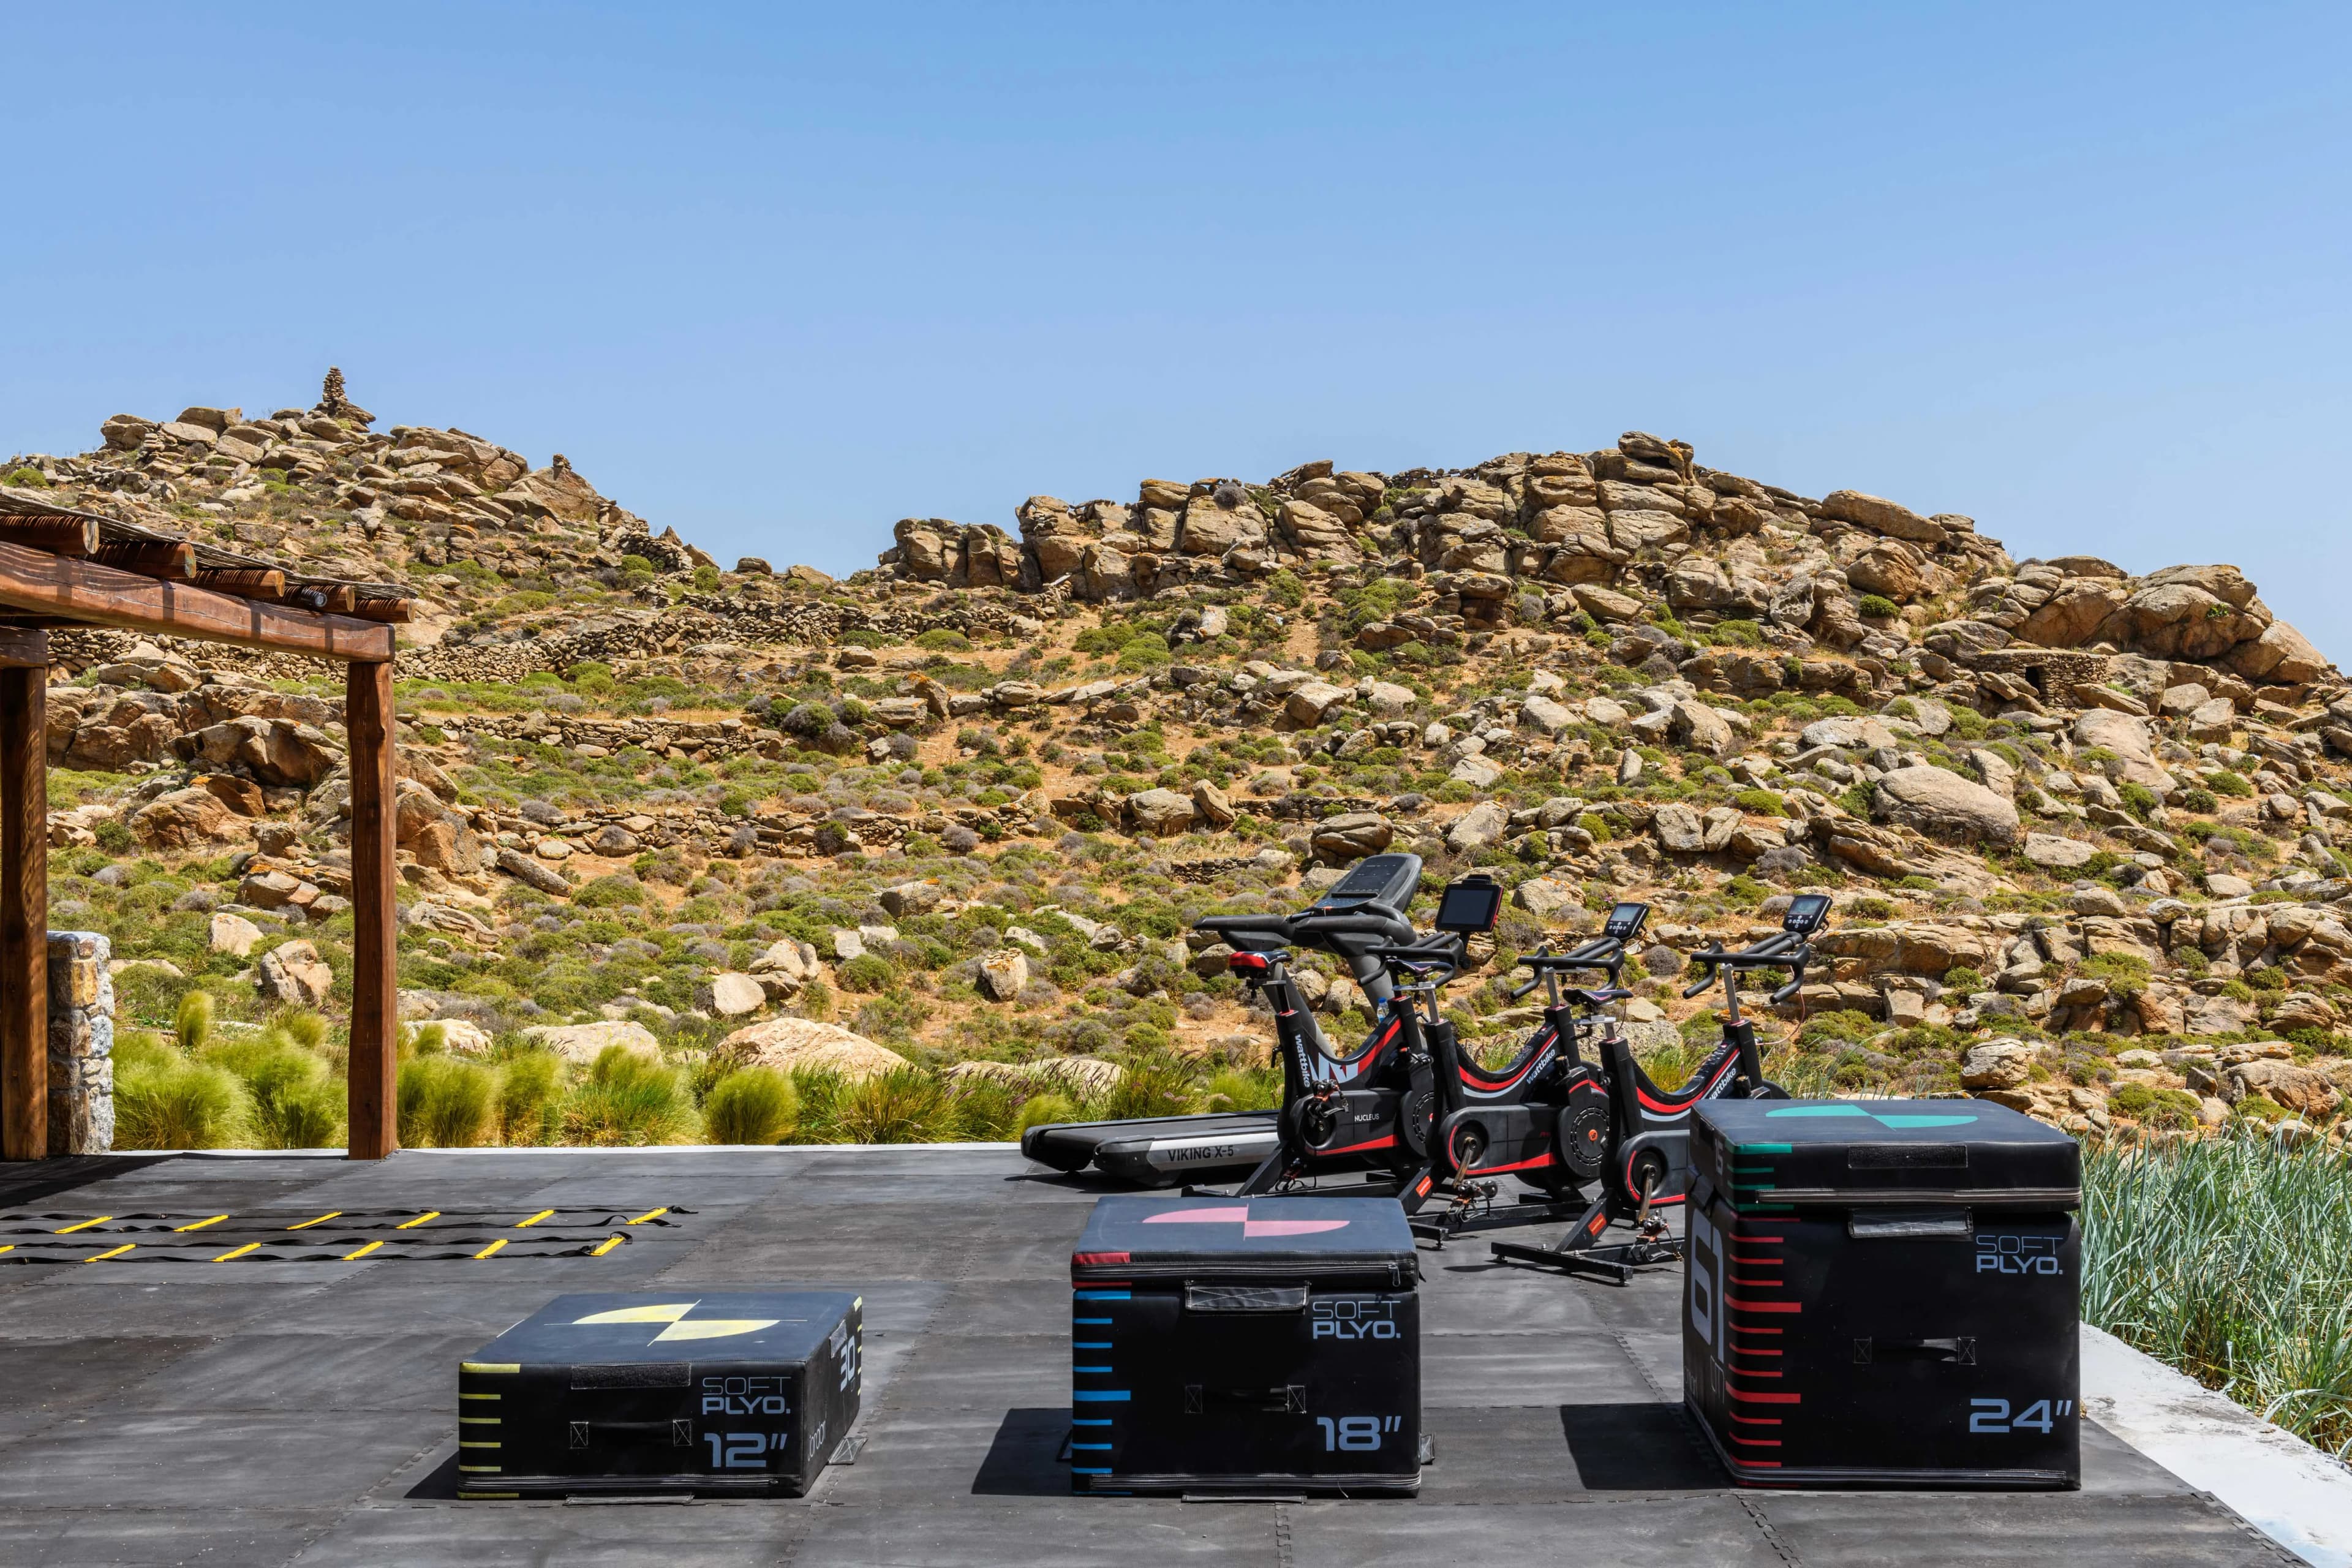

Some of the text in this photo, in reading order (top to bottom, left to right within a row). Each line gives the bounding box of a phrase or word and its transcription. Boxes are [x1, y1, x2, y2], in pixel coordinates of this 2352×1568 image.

[1294, 1033, 1311, 1088] wattbike
[1526, 1048, 1556, 1085] wattbike
[1354, 1113, 1380, 1122] NUCLEUS
[1167, 1145, 1234, 1162] VIKING X-5
[1976, 1235, 2064, 1255] SOFT
[1976, 1254, 2064, 1275] PLYO.
[1691, 1207, 1724, 1364] 61
[1313, 1300, 1401, 1319] SOFT
[1313, 1321, 1401, 1340] PLYO.
[840, 1335, 856, 1392] 30
[703, 1376, 791, 1395] SOFT
[702, 1396, 791, 1415] PLYO.
[1969, 1398, 2072, 1433] 24"
[1317, 1415, 1401, 1451] 18"
[704, 1433, 788, 1468] 12"
